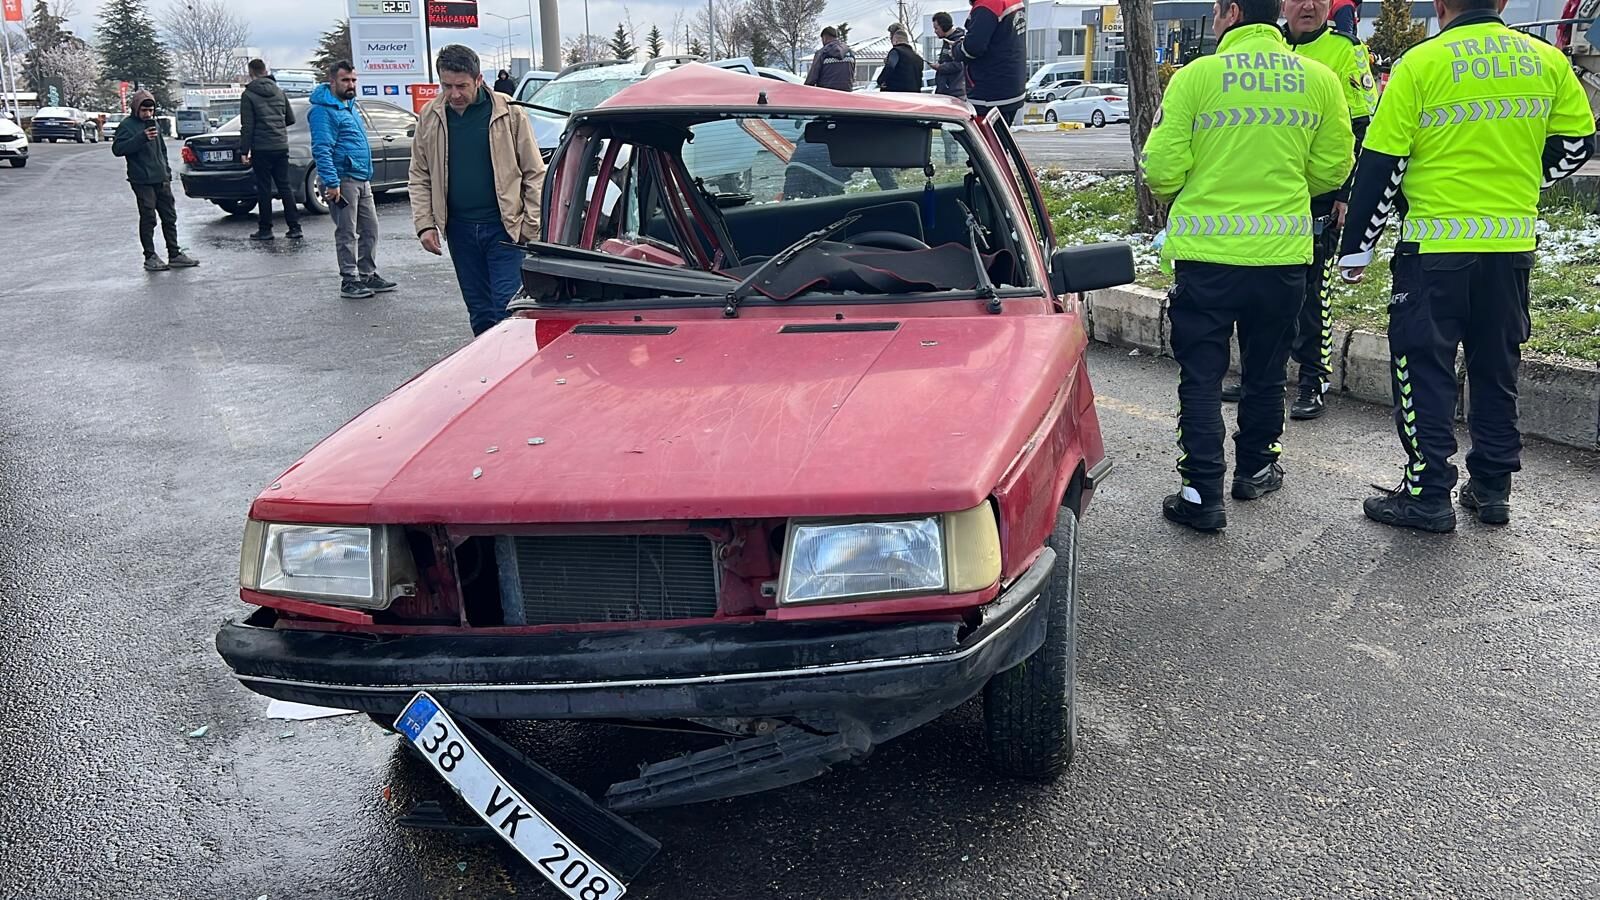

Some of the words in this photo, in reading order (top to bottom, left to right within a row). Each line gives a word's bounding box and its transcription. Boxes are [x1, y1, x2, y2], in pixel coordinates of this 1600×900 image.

[383, 1, 410, 12] 62.90
[429, 15, 477, 24] KAMPANYA
[367, 43, 407, 51] Market
[405, 716, 421, 734] TR
[421, 722, 465, 772] 38
[485, 785, 532, 839] VK
[538, 842, 610, 900] 208
